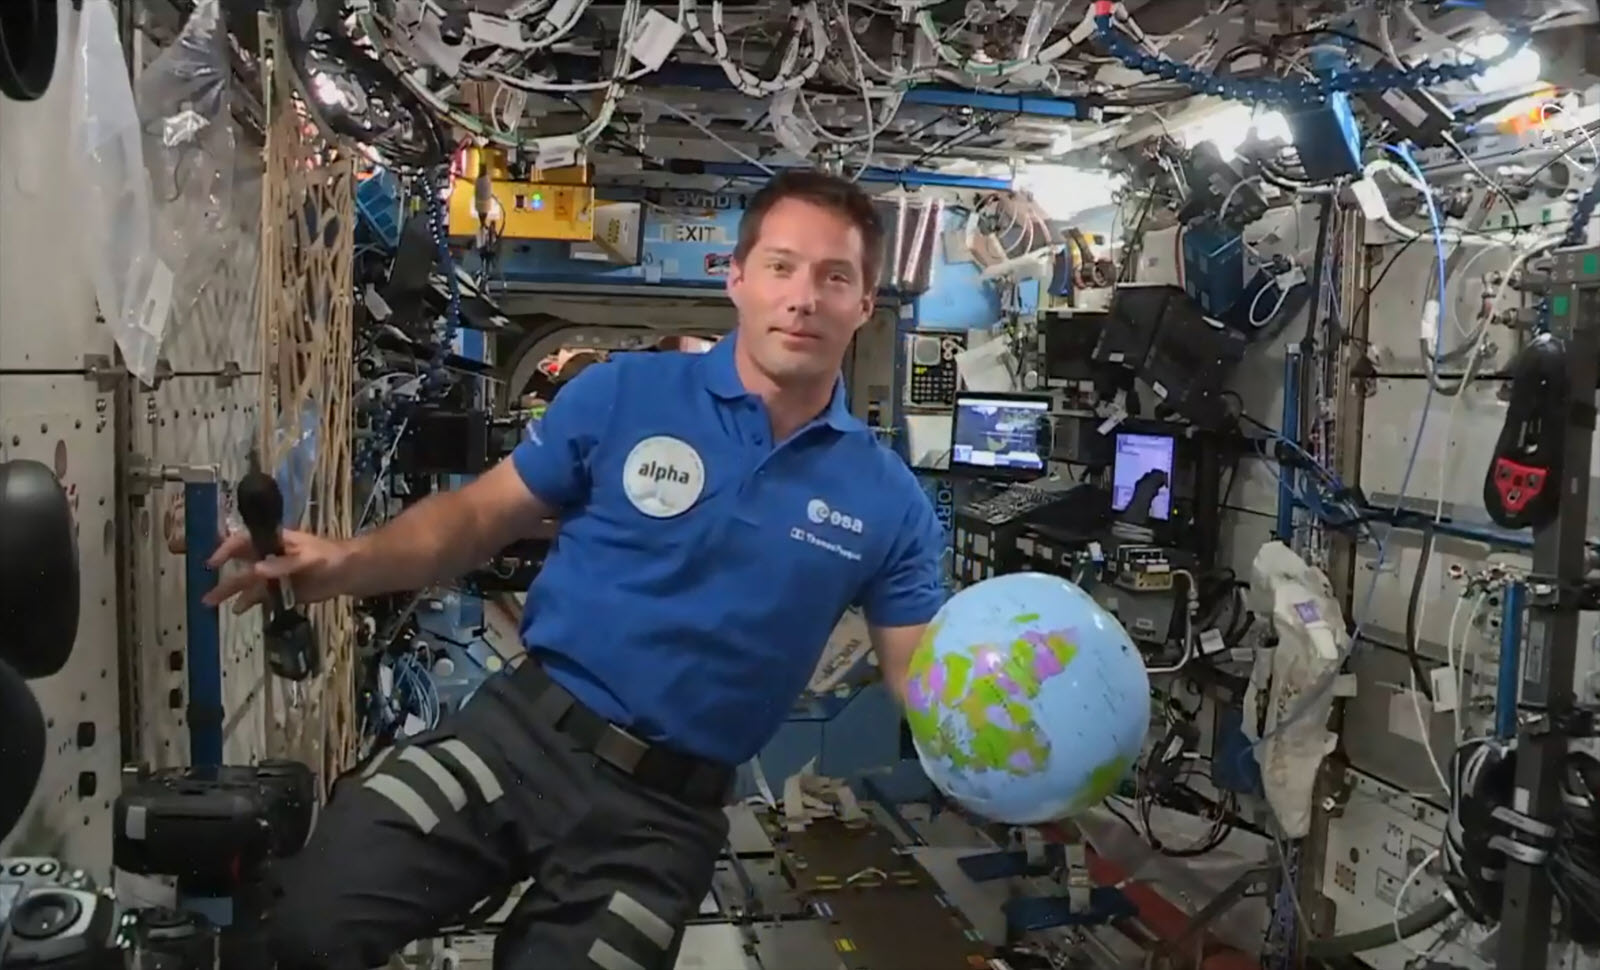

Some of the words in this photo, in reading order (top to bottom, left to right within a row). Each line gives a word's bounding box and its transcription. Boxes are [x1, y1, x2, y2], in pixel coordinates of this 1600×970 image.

[676, 225, 716, 242] EXIT
[638, 460, 690, 485] alpha
[830, 510, 863, 534] esa
